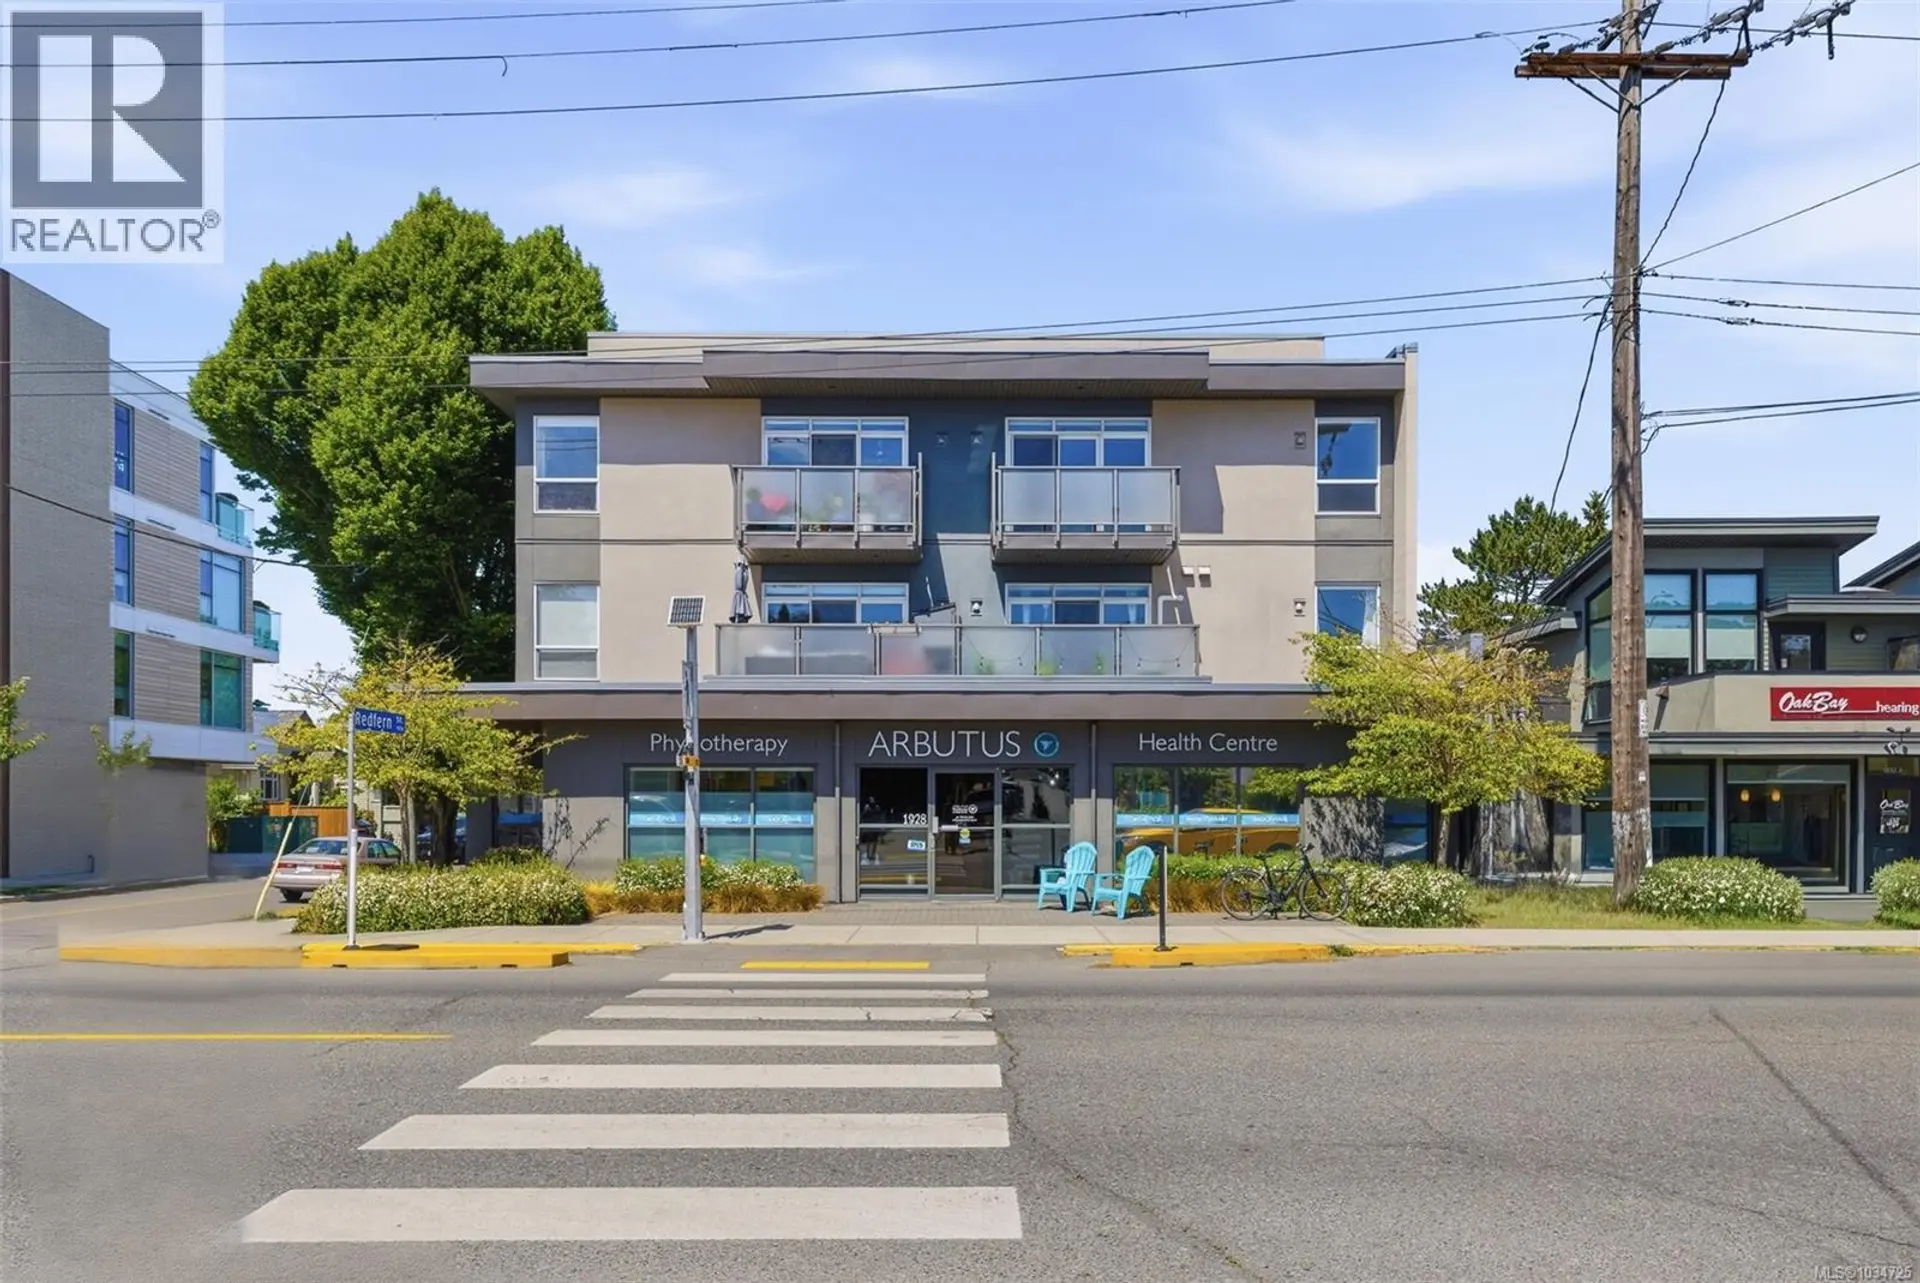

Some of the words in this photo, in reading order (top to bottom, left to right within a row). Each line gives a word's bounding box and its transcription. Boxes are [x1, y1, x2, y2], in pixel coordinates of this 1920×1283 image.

[1875, 700, 1920, 716] hearing
[650, 733, 788, 757] Phyotherapy
[868, 730, 1021, 757] ARBUTUS
[1139, 732, 1202, 751] Health
[1209, 732, 1278, 752] Centre
[903, 813, 927, 825] 1928
